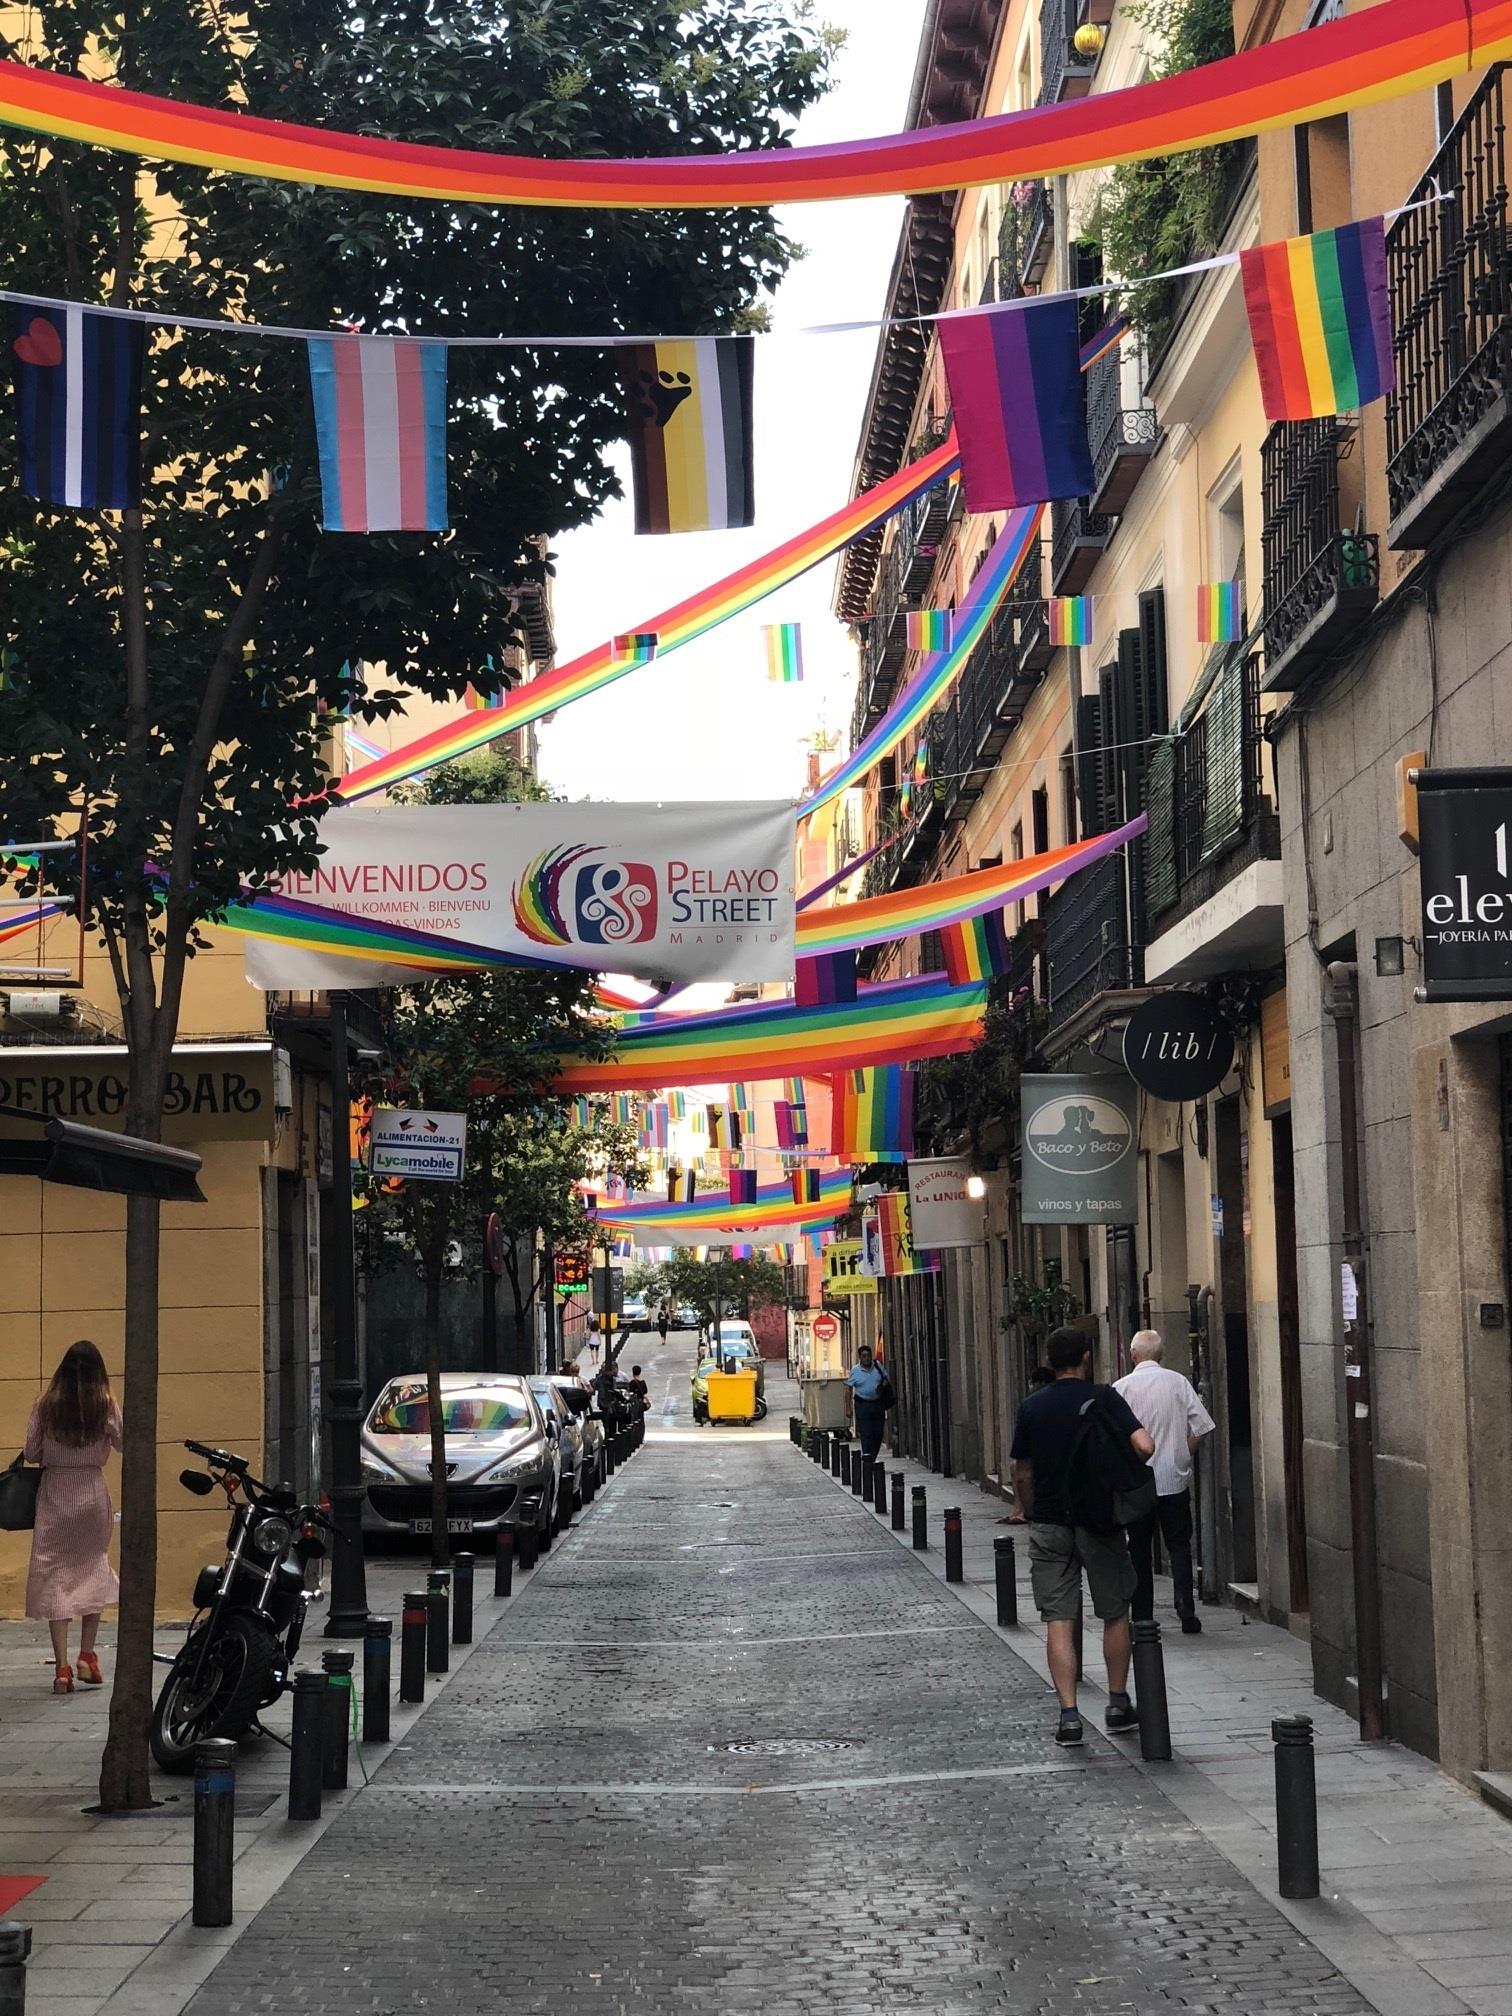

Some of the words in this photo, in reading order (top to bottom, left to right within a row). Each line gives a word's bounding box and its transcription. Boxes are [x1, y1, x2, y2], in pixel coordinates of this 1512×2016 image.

[668, 861, 779, 894] PELAYO
[429, 900, 491, 912] BIENVENU
[672, 889, 778, 923] STREET
[1426, 874, 1512, 924] ele
[670, 932, 778, 945] MADRID
[162, 1072, 261, 1116] BAR
[377, 1132, 460, 1145] ALIMENTACION-21
[1037, 1141, 1074, 1154] Baco
[1076, 1143, 1086, 1156] y
[1089, 1140, 1123, 1153] Beto
[377, 1153, 455, 1170] Lycamobile
[914, 1170, 966, 1190] RESTAURAN
[933, 1191, 967, 1202] UNIO
[1038, 1199, 1072, 1210] vinos
[1075, 1201, 1083, 1212] y
[1086, 1199, 1122, 1212] tapas
[830, 1255, 863, 1277] lif
